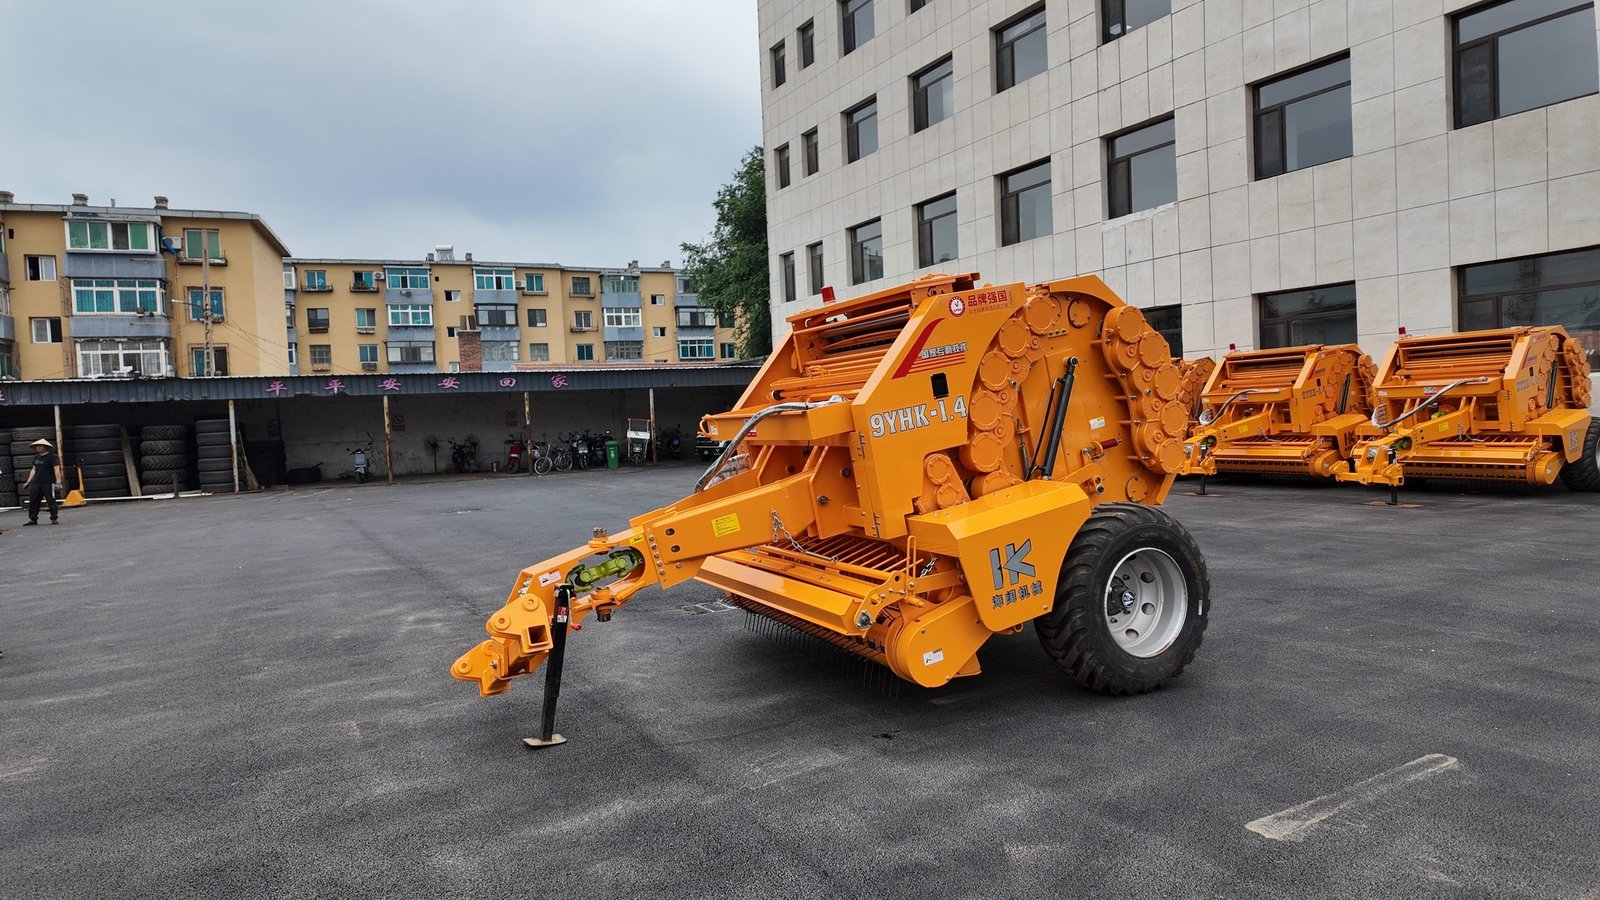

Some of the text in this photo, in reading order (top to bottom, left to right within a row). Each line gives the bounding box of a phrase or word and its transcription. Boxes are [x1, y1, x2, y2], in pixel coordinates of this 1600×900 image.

[968, 290, 1007, 306] 品牌强国
[265, 374, 568, 397] 平平安安回家
[870, 396, 967, 437] 9YHK-1.4
